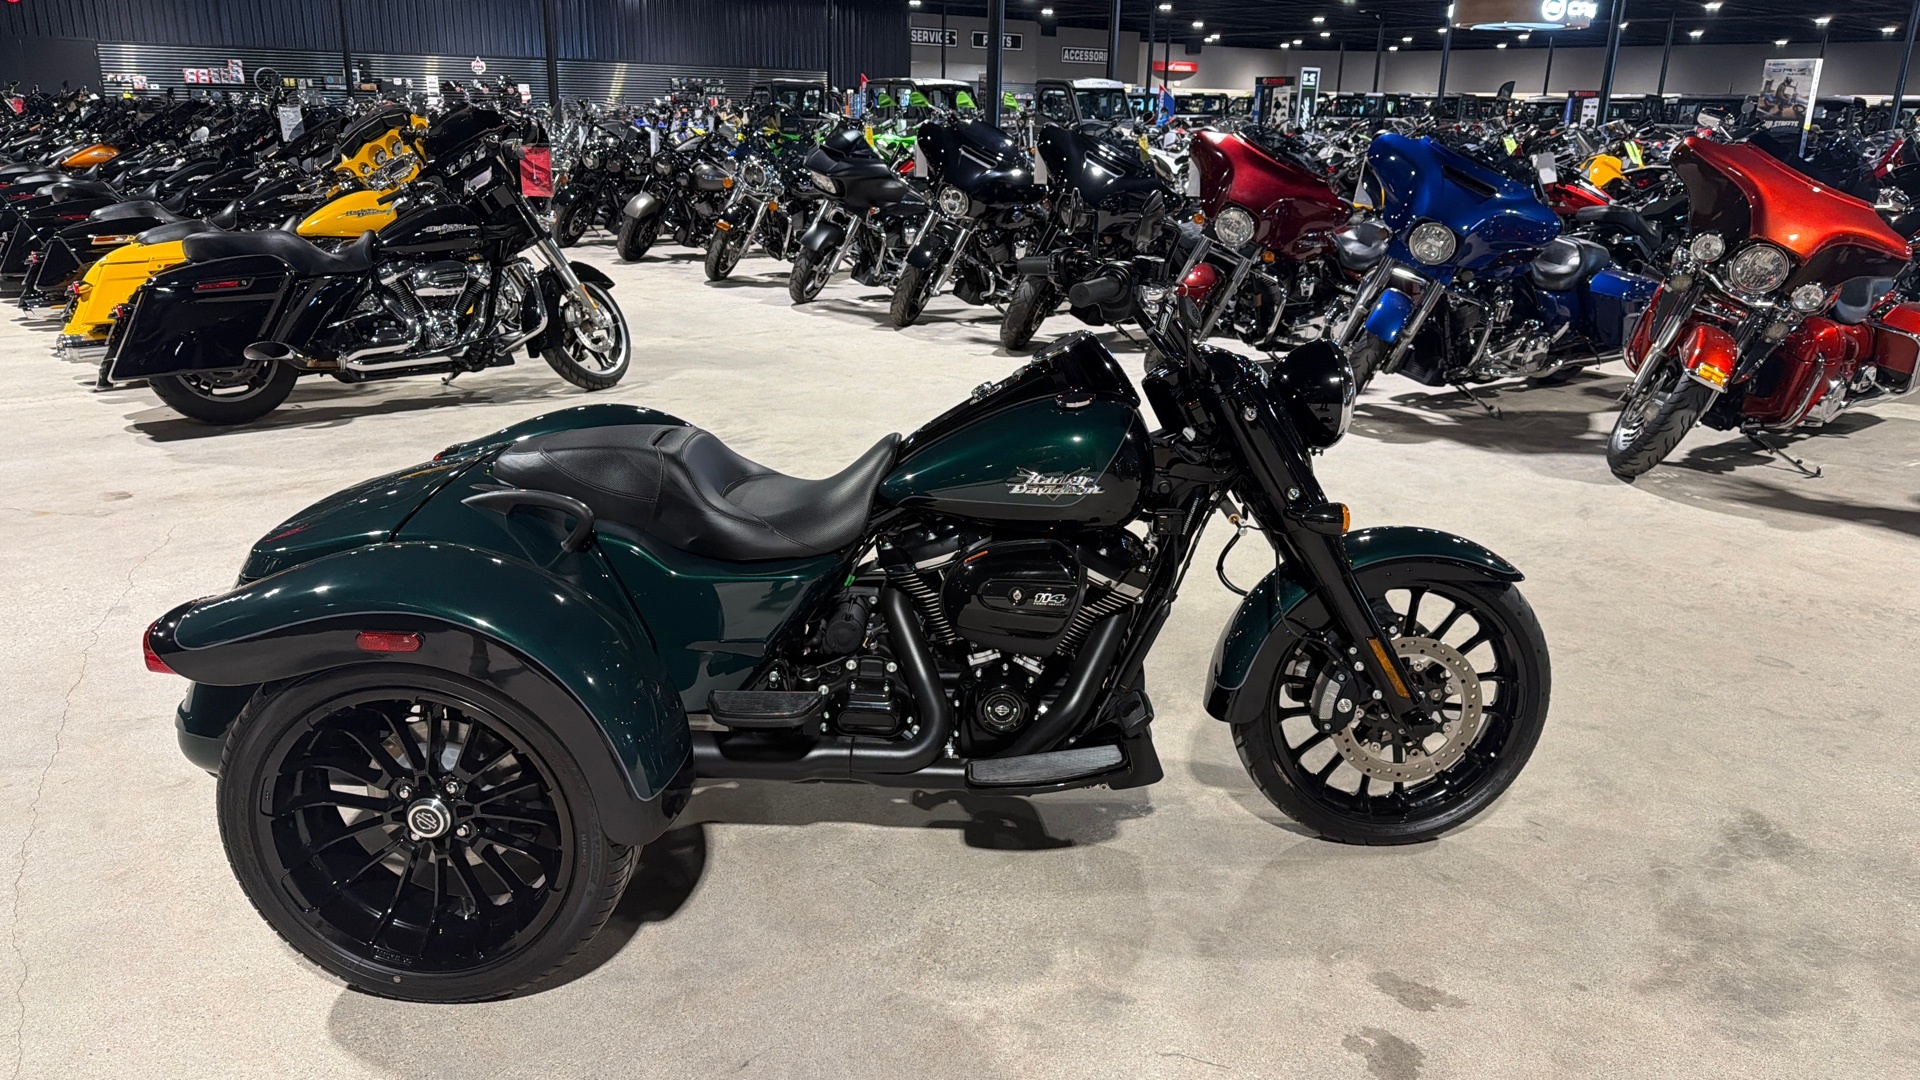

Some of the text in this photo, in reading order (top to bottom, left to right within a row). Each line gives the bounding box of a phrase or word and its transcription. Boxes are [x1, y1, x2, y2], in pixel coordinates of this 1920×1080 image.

[911, 29, 950, 43] SERVICE
[982, 34, 1012, 47] PTS
[1063, 49, 1108, 62] ACCESSORI
[1034, 592, 1067, 604] 114
